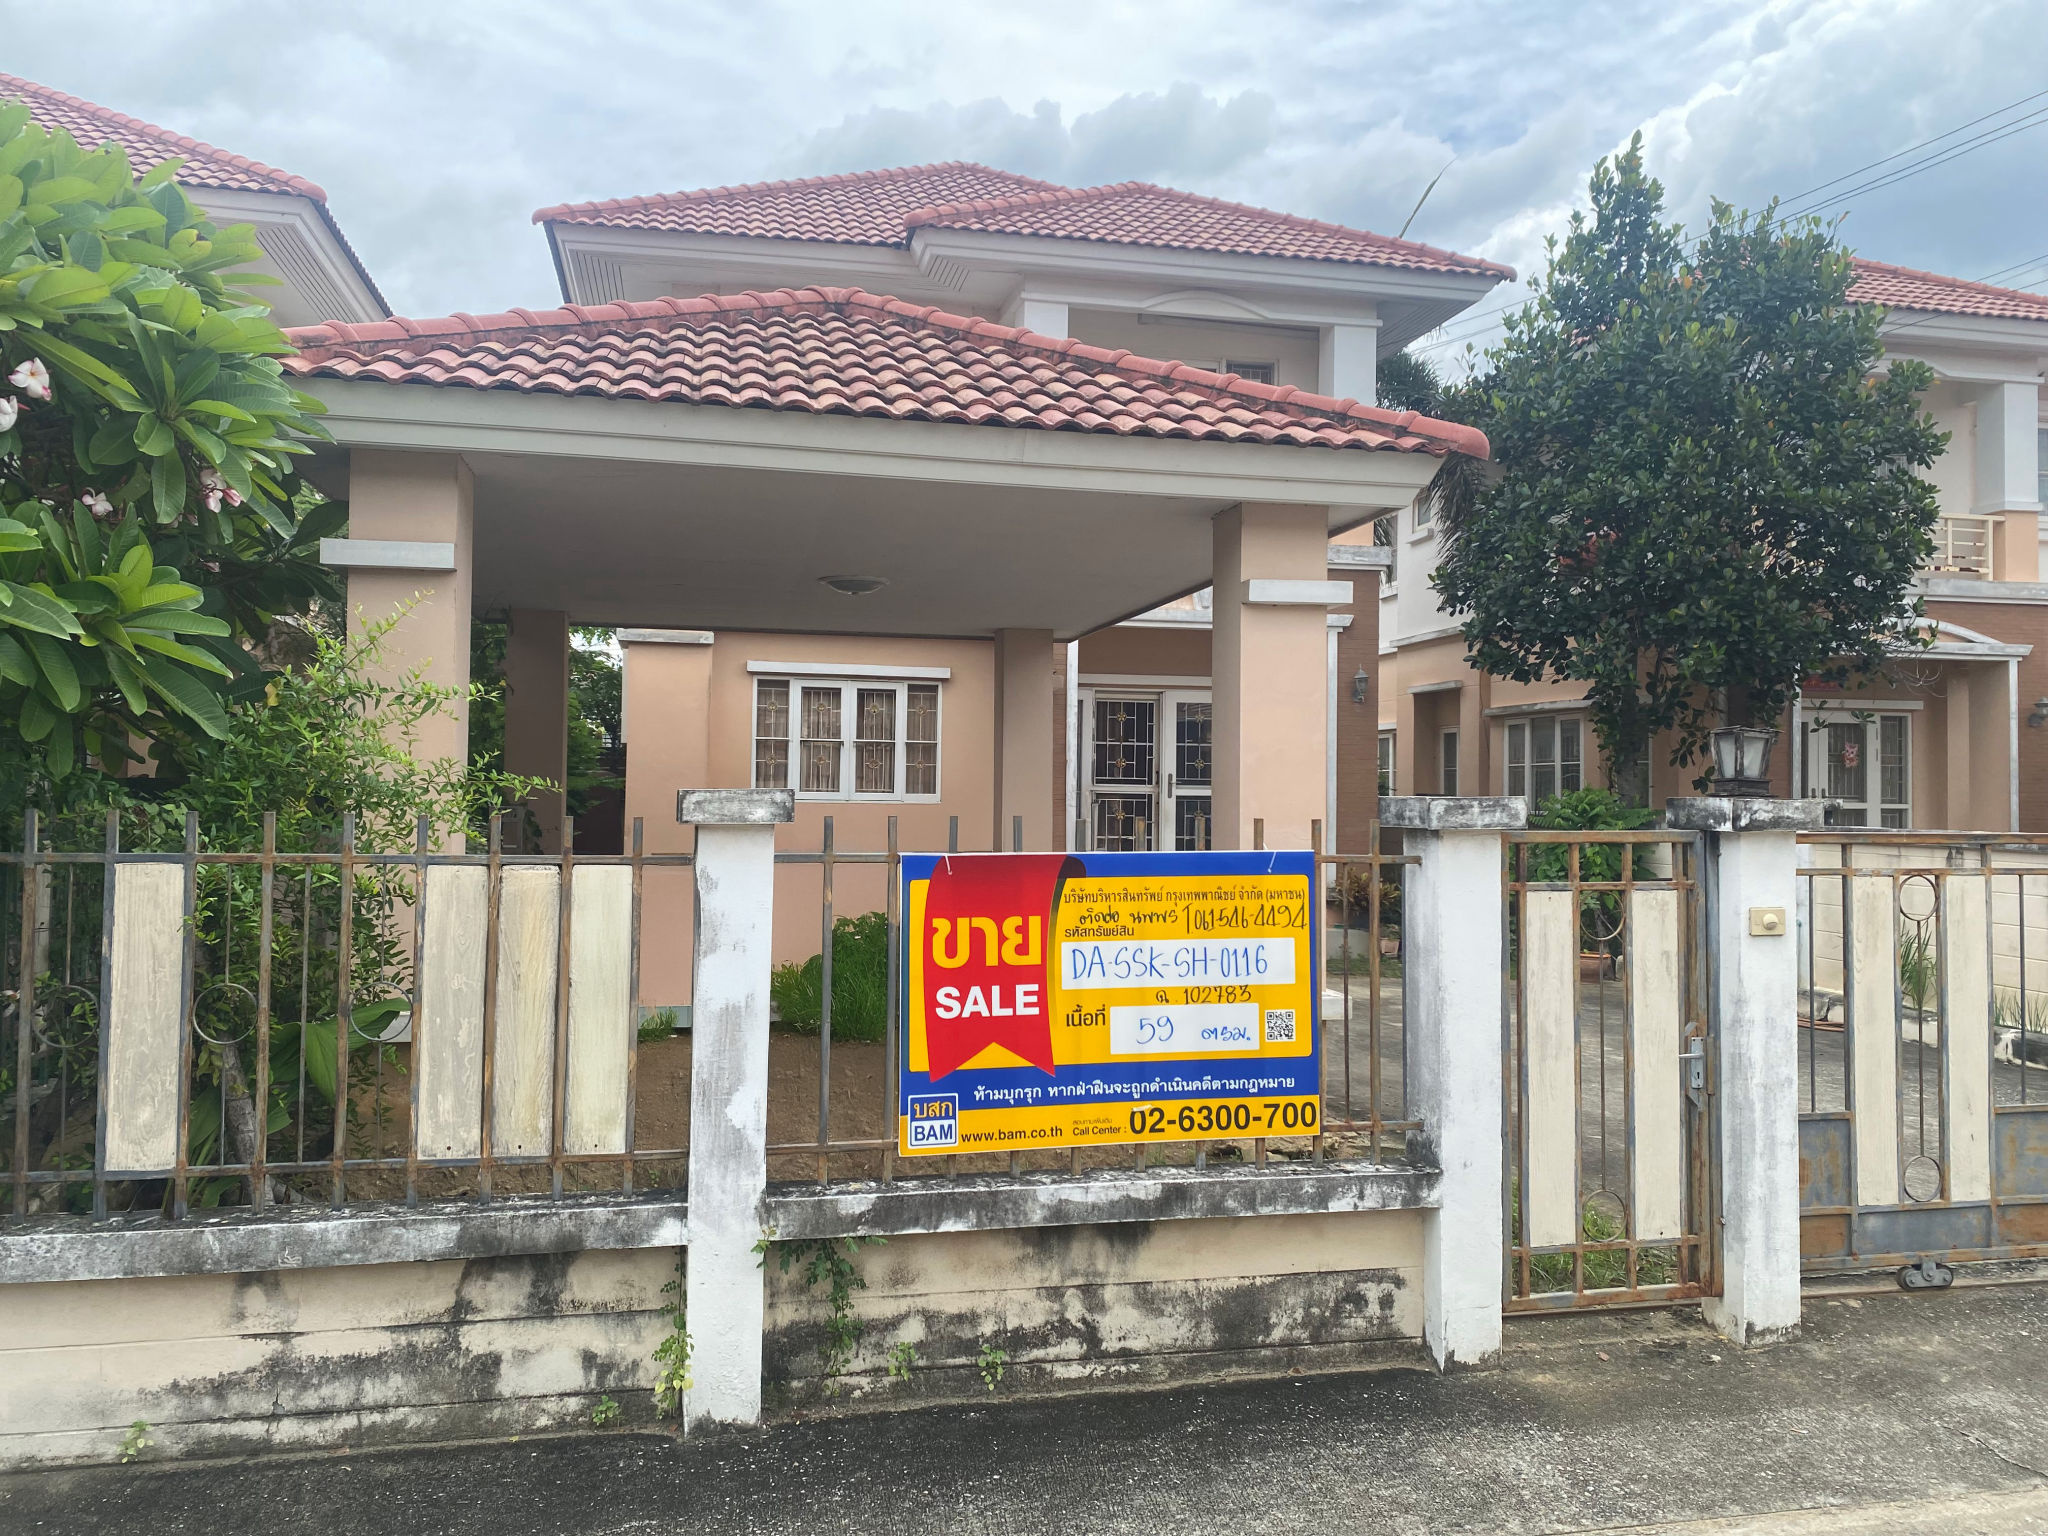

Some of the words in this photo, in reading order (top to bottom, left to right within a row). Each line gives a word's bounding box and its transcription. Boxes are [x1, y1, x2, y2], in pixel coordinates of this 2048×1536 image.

[1064, 886, 1164, 904] บริษัทบริหารสินทรัพย์
[1166, 885, 1236, 907] กรุงเทพพาณิชย์
[1239, 886, 1263, 901] จำกัด
[1266, 888, 1305, 902] (มหาชน)
[932, 915, 1041, 969] ขาย
[1064, 925, 1135, 938] รหัสทรัพย์สิน
[935, 984, 1040, 1019] SALE
[1184, 984, 1252, 1005] 102783
[1066, 1004, 1106, 1028] เนื้อที่
[1136, 1015, 1174, 1045] 59
[973, 1085, 1042, 1105] ห้ามบุกรุก
[1048, 1076, 1295, 1099] หากฝ่าฝืนจะถูกดำเนินคดีตามกฎหมาย
[913, 1100, 953, 1119] บสก
[1129, 1102, 1317, 1134] 02-6300-700
[914, 1123, 953, 1142] BAM
[961, 1126, 1063, 1143] www.bam.co.th
[1072, 1127, 1090, 1136] Call
[1091, 1126, 1121, 1135] Center
